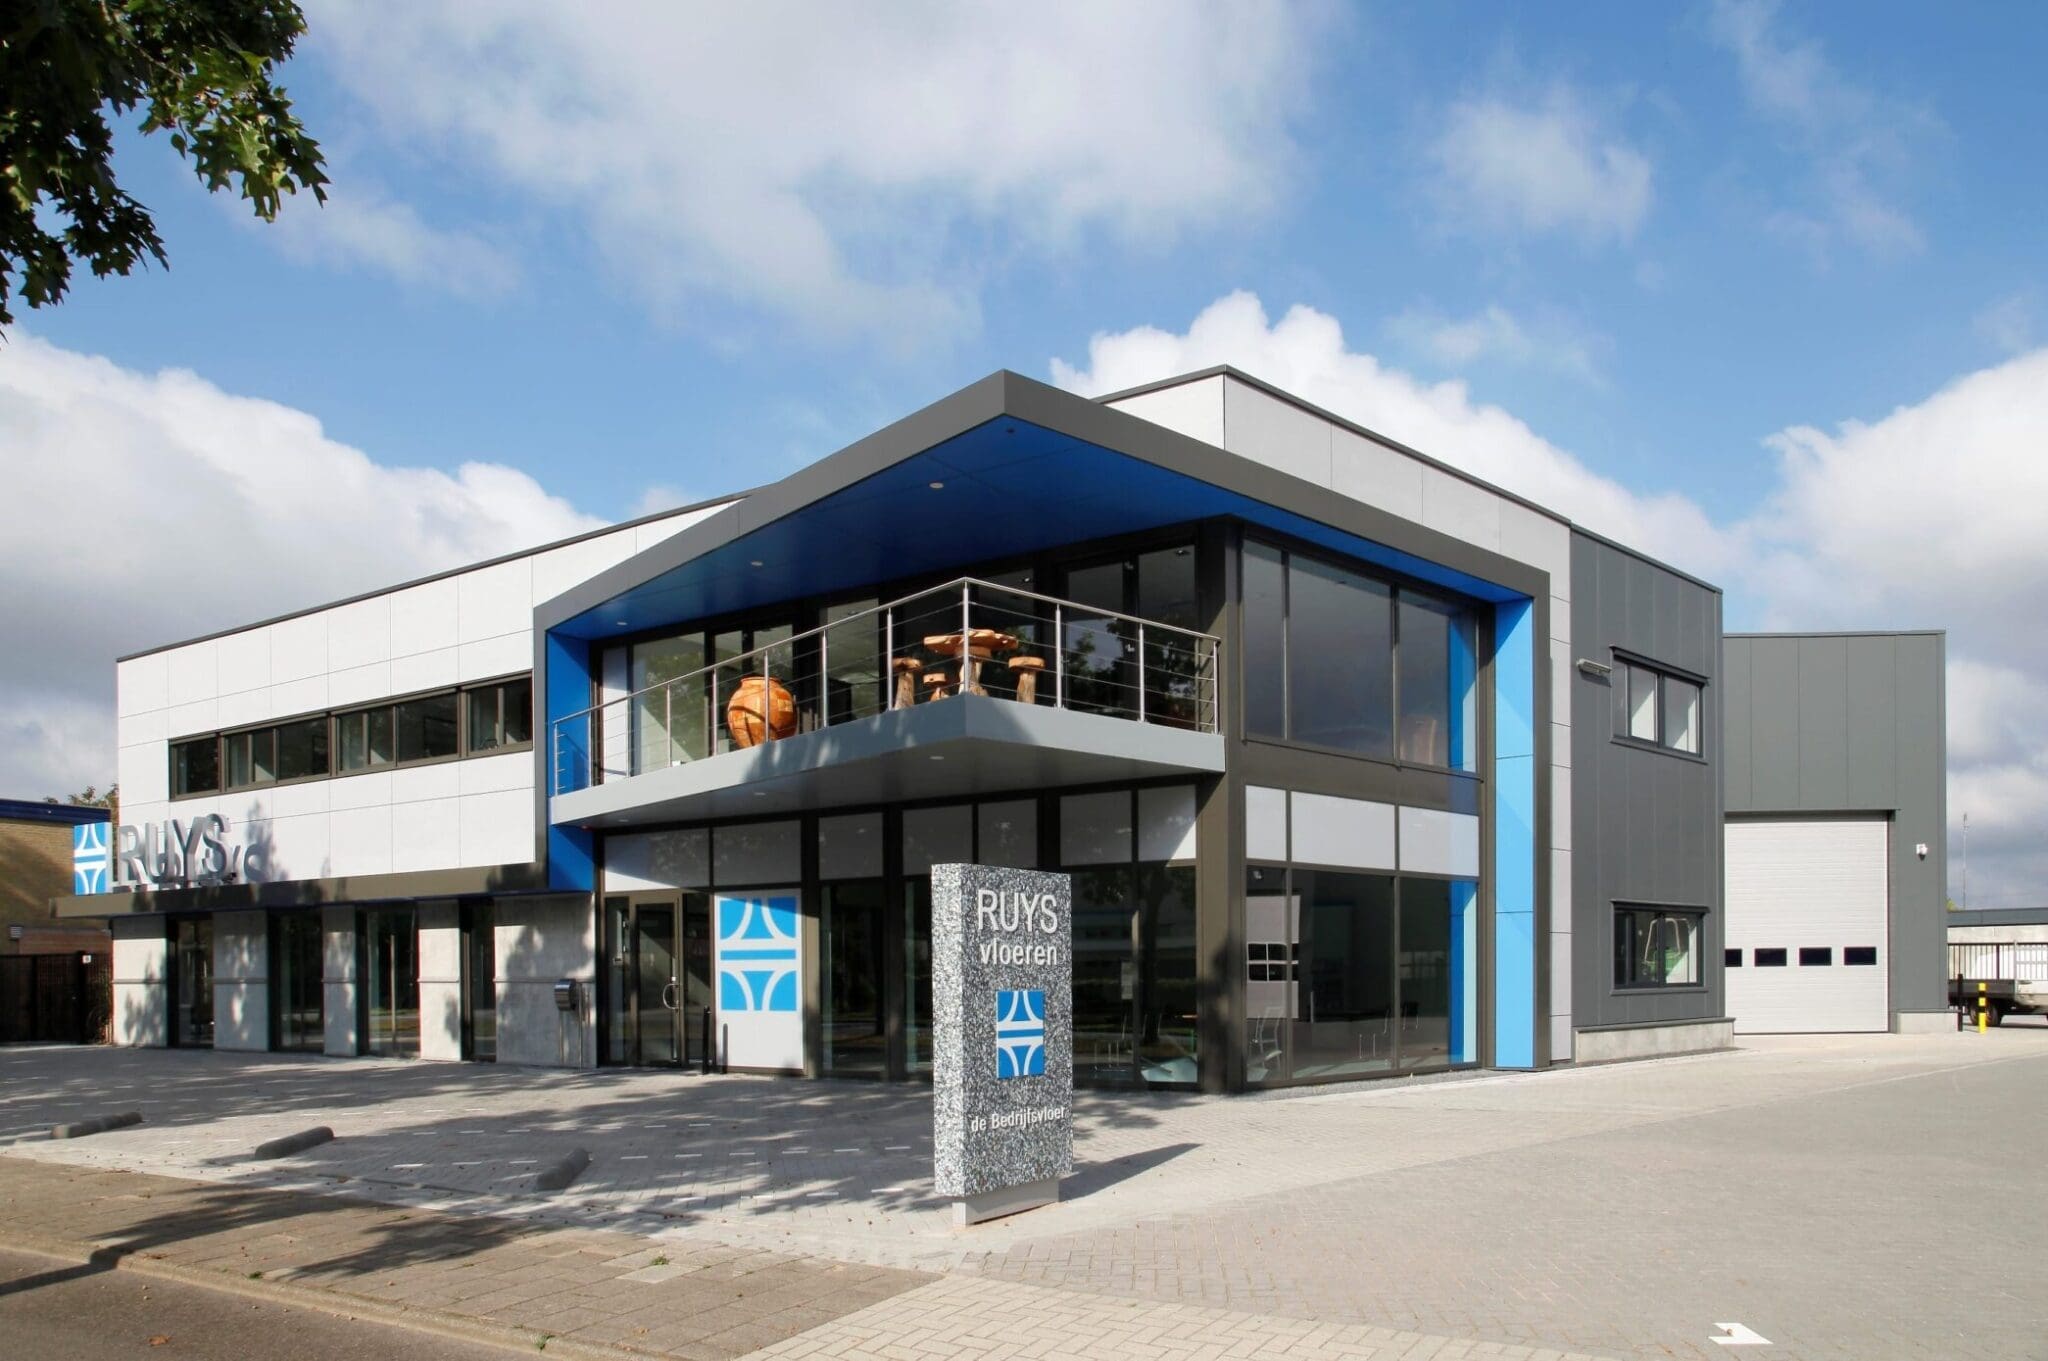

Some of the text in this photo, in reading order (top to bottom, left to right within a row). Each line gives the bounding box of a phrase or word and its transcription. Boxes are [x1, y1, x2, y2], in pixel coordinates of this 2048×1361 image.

[118, 814, 231, 889] RUYS
[977, 888, 1058, 934] RUYS
[979, 942, 1058, 966] vloeren
[971, 1106, 1066, 1132] de Bedrijfsvloer
